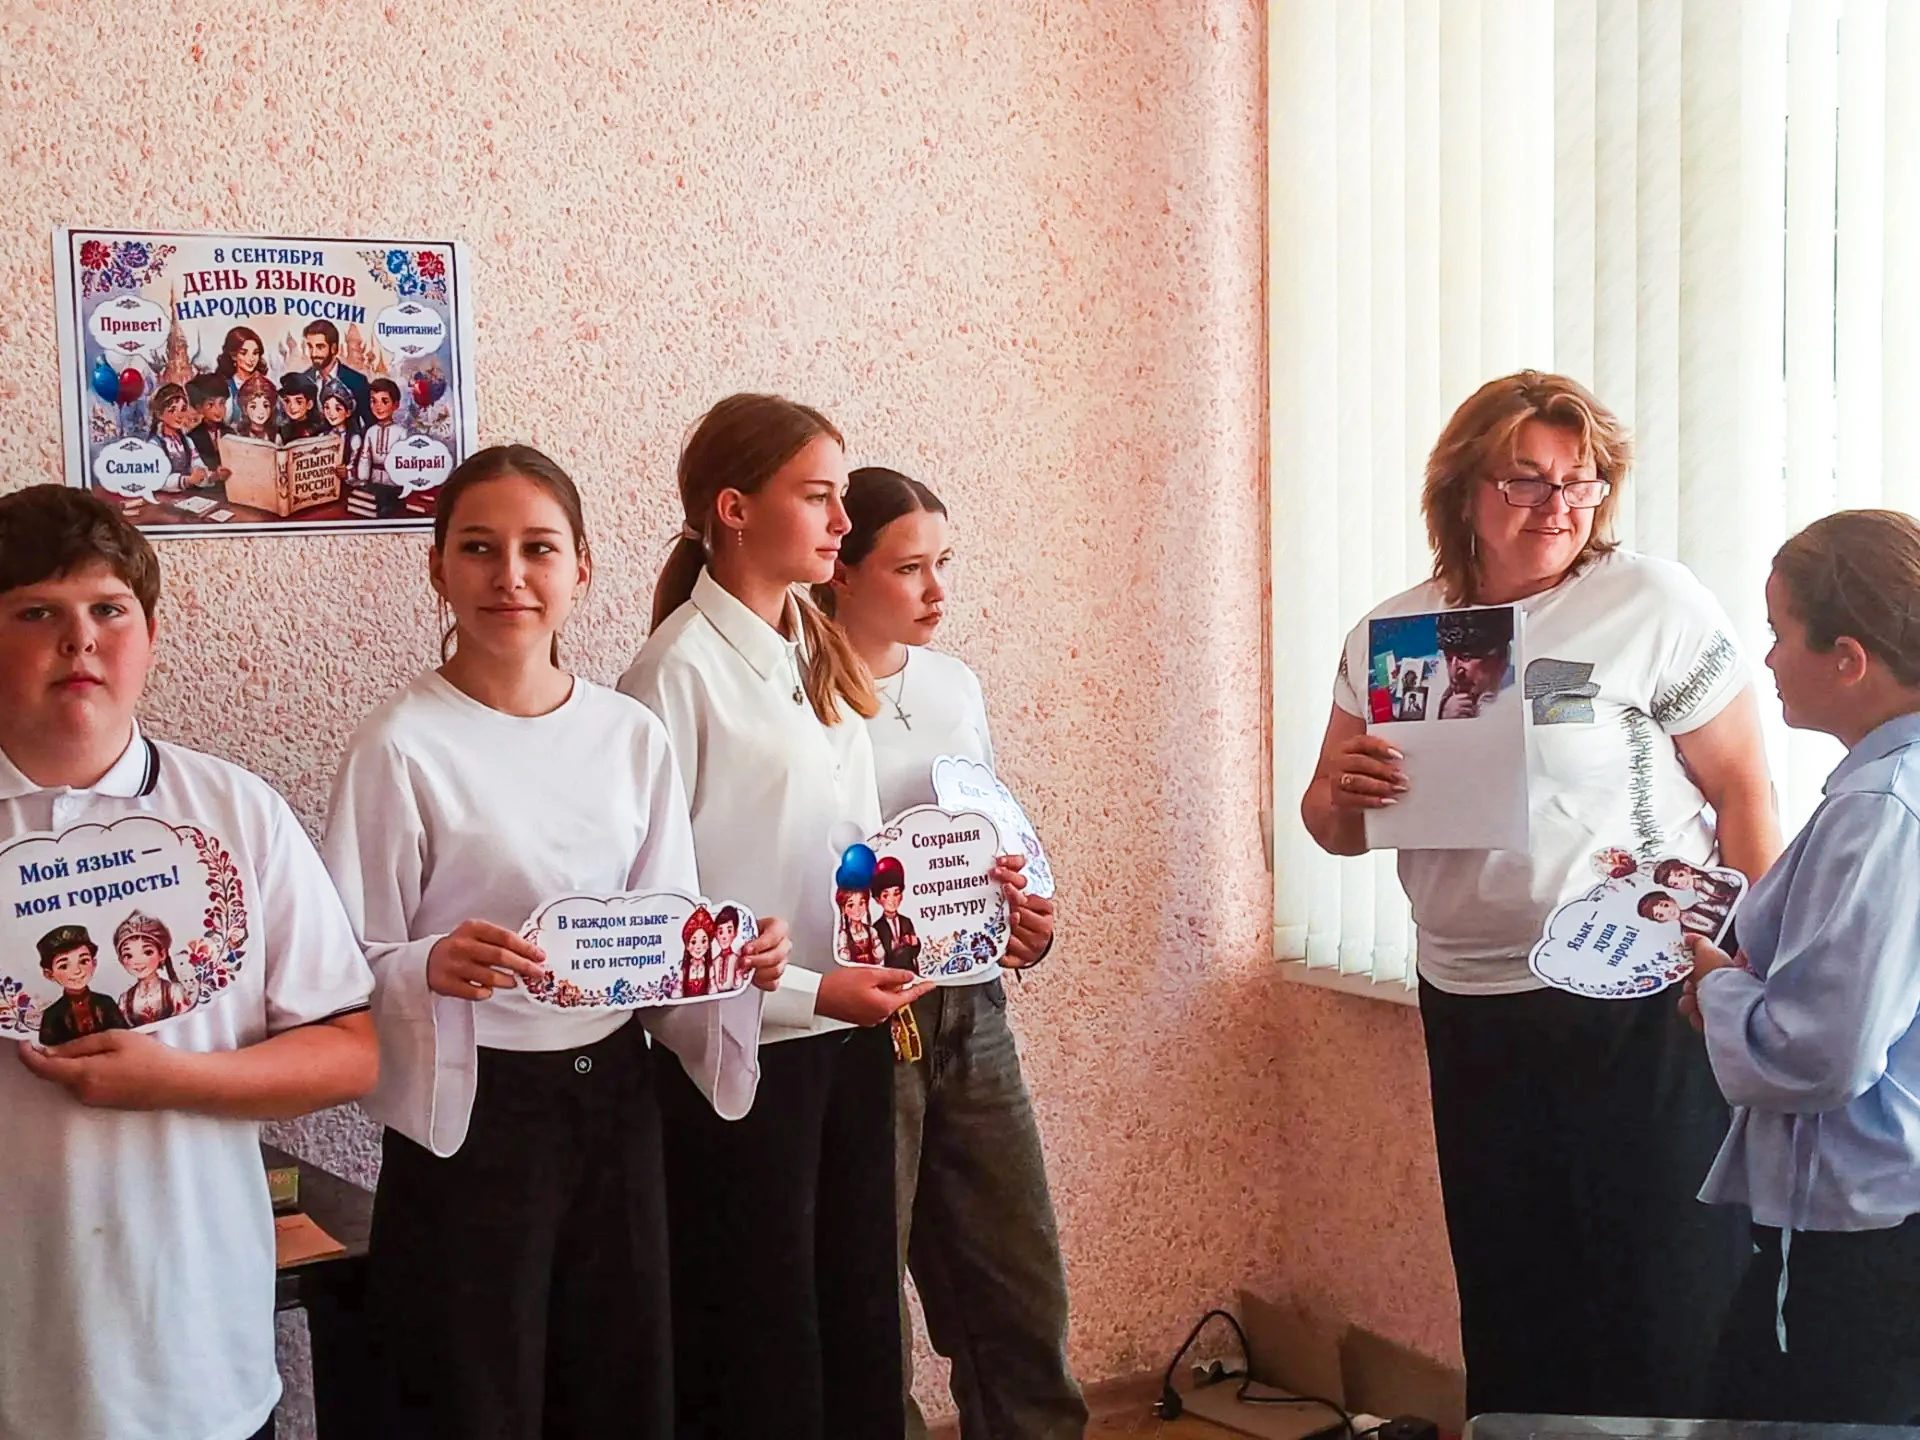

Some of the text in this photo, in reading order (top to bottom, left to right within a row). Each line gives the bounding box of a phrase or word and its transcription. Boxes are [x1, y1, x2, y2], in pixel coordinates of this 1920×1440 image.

[214, 248, 324, 267] 8 СЕНТЯБРЯ
[183, 269, 357, 298] ДЕНЬ ЯЗЫКОВ
[176, 296, 366, 325] НАРОДОВ РОССИИ
[100, 316, 162, 335] Привет!
[105, 458, 160, 474] Салам!
[295, 453, 335, 471] ЯЗЫКИ
[395, 455, 445, 472] Байрай!
[295, 476, 335, 495] РОССИИ
[912, 828, 980, 849] Сохраняя
[19, 858, 70, 886] Мой
[76, 848, 136, 876] язык
[928, 853, 970, 870] язык,
[15, 865, 180, 919] моя гордость!
[912, 874, 989, 896] сохраняем
[919, 897, 987, 921] культуру
[558, 915, 567, 930] В
[571, 914, 627, 930] каждом
[629, 913, 669, 927] языке
[576, 934, 662, 950] голос народа
[1567, 920, 1594, 951] Язык
[1593, 923, 1617, 953] душа
[1607, 925, 1640, 967] народа!
[571, 951, 666, 970] и его история!
